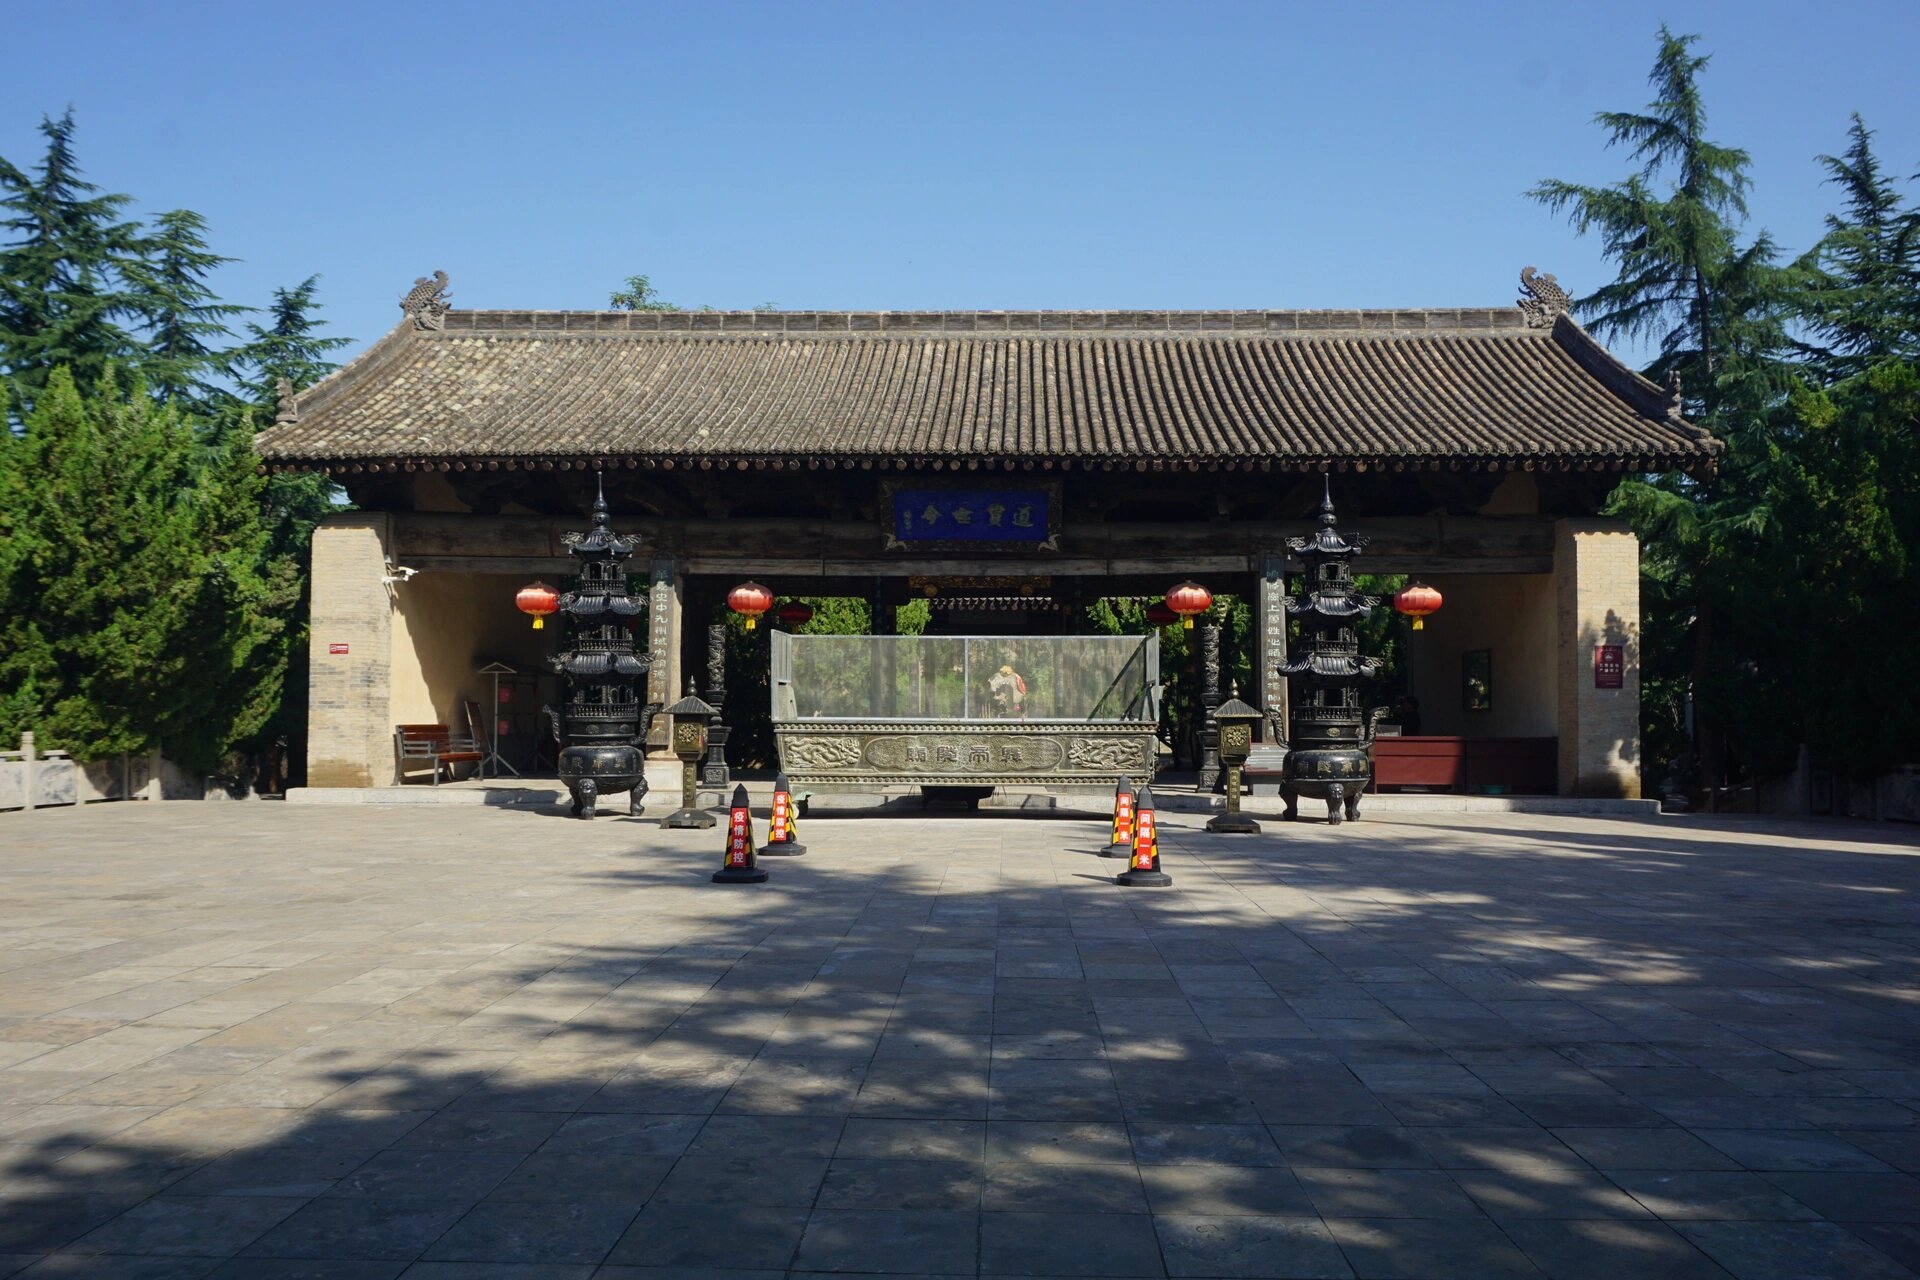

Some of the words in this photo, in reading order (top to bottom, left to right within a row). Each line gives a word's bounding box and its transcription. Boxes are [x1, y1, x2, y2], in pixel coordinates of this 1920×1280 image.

[733, 811, 745, 863] 疫情防控
[775, 794, 786, 839] 疫情防控
[1119, 796, 1129, 841] 间隔一米
[1139, 813, 1150, 866] 间隔一米
